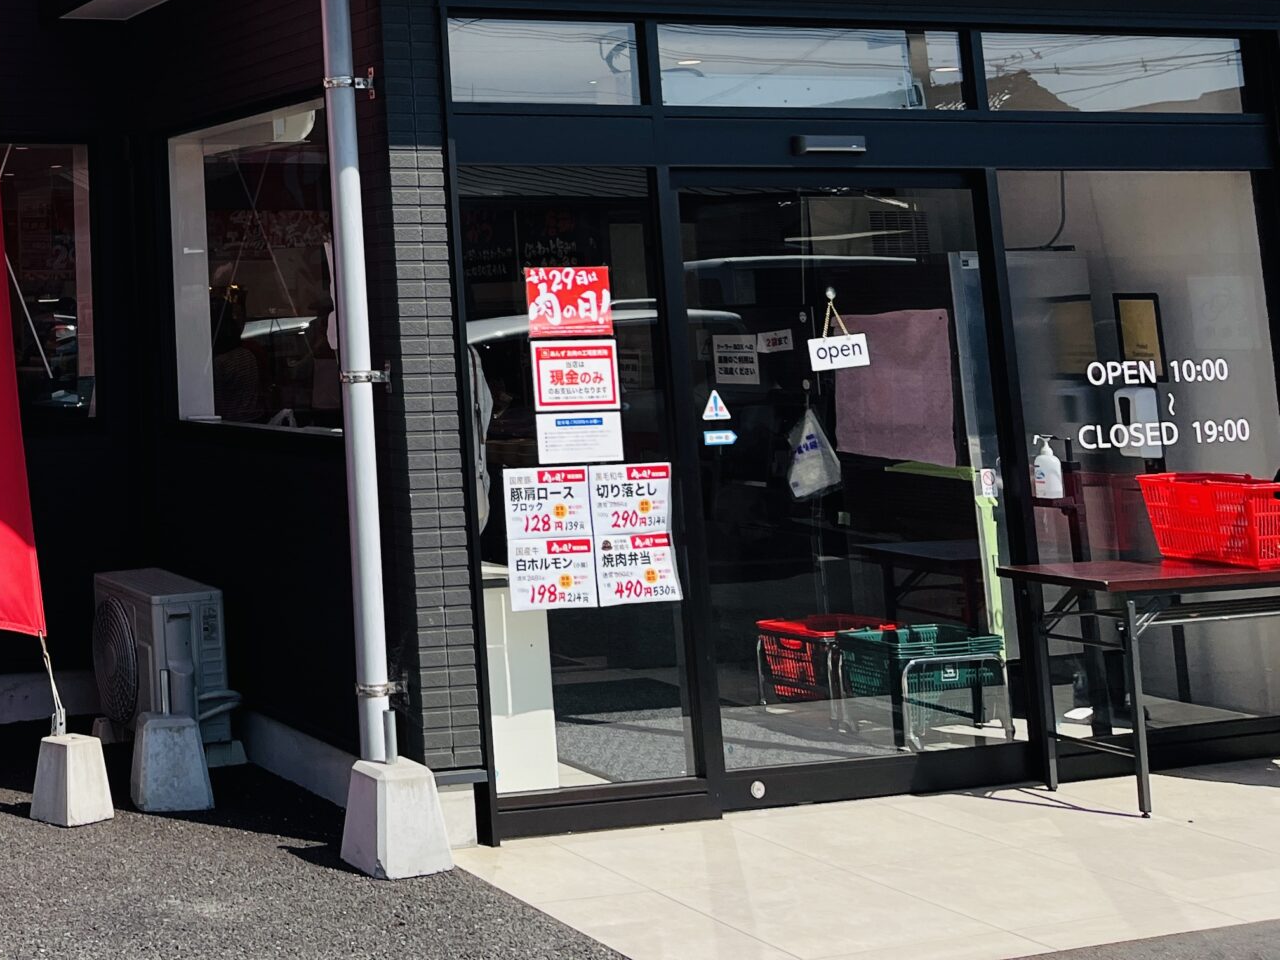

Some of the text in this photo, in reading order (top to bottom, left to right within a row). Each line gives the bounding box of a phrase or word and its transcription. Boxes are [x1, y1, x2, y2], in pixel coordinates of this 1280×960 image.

[816, 342, 863, 365] open
[549, 369, 604, 386] 現金のみ
[1087, 358, 1229, 385] OPEN 10:00
[1078, 418, 1250, 449] CLOSED 19:00
[510, 486, 574, 501] 豚肩ロース
[596, 482, 657, 498] 切り落とし
[512, 502, 543, 512] ブロック
[516, 557, 573, 571] 白ホルモン
[602, 551, 651, 568] 焼肉弁当
